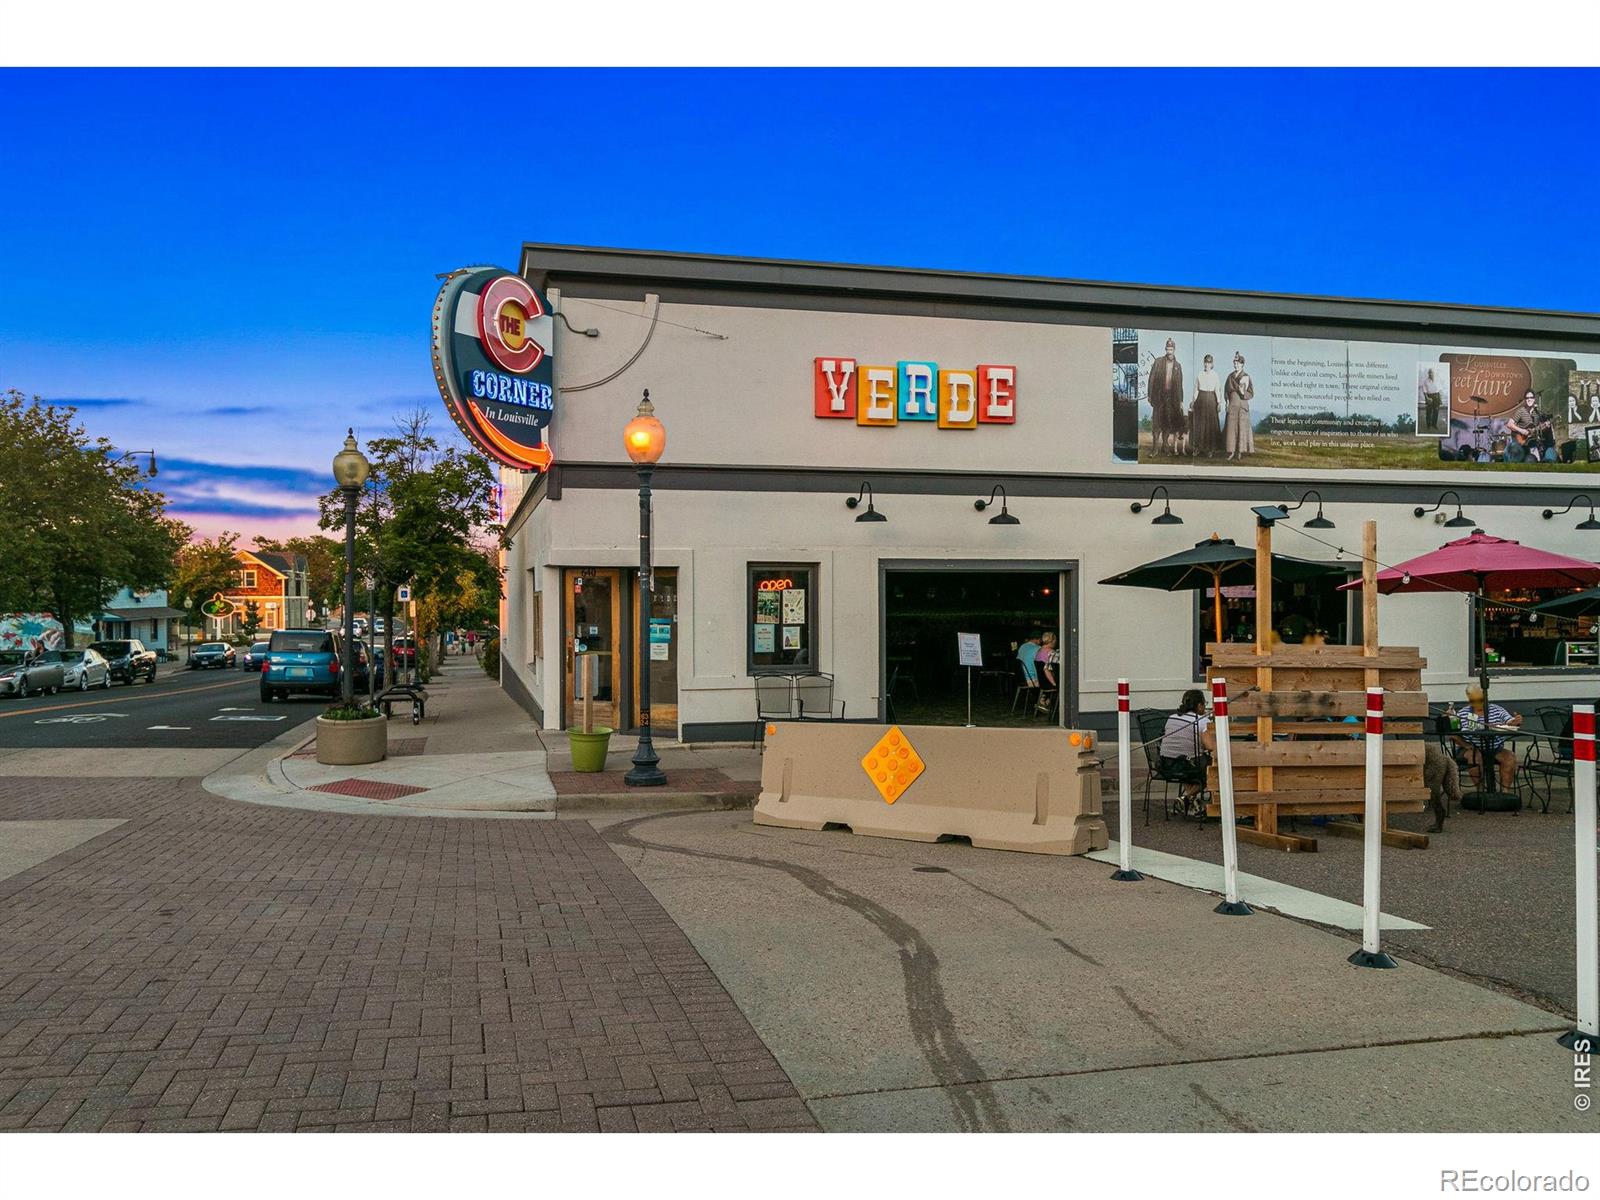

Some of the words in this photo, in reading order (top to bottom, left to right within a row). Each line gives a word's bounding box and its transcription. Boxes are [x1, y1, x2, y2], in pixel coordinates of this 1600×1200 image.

[500, 314, 521, 337] THE
[1297, 359, 1326, 368] beginning,
[1271, 369, 1290, 377] Unlike
[1306, 370, 1318, 378] coal
[471, 368, 553, 411] CORNER
[819, 359, 1014, 422] VERDE
[1304, 382, 1317, 390] right
[1341, 382, 1358, 390] Tese
[1354, 393, 1366, 401] who
[485, 406, 495, 419] In
[497, 408, 539, 427] Louisville
[1282, 439, 1297, 447] work
[1309, 440, 1321, 449] play
[1328, 440, 1339, 448] this
[760, 579, 793, 591] open
